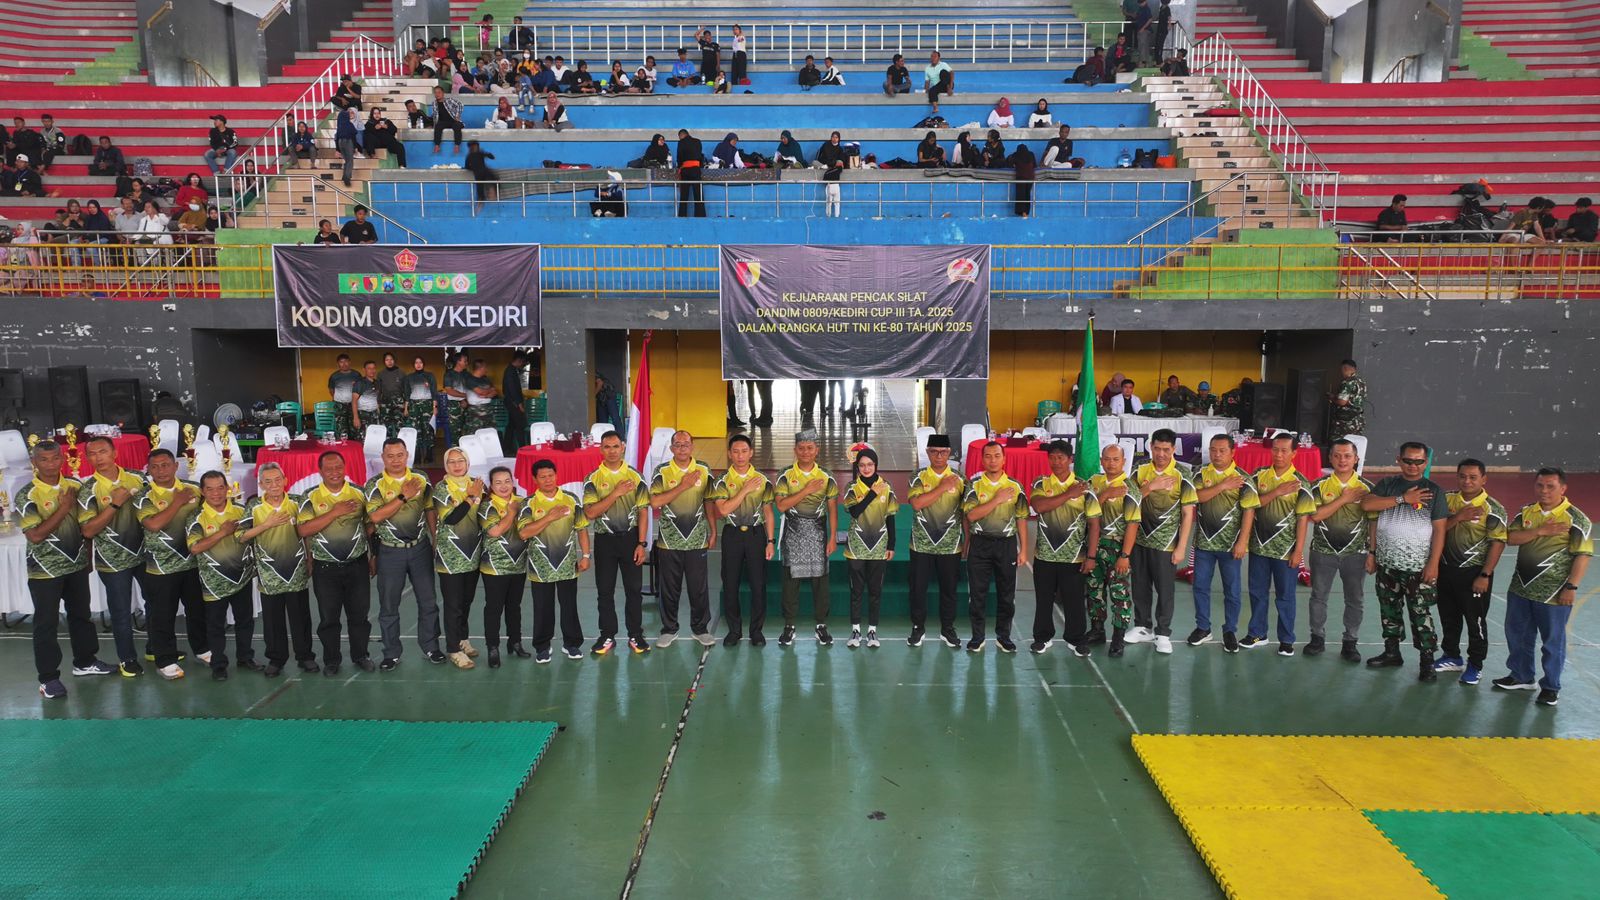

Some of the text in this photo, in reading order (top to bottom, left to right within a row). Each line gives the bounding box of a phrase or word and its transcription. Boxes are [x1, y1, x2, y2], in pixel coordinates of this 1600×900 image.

[782, 292, 928, 302] KEJUARAAN PENCAK SILAT
[291, 305, 527, 328] KODIM 0809/KEDIRI
[756, 307, 954, 318] DANDIM 0809/KEDIRI CUP III TA. 2025
[738, 322, 973, 333] DALAM RANGKA HUT TNI KE-80 TAHUN 2025
